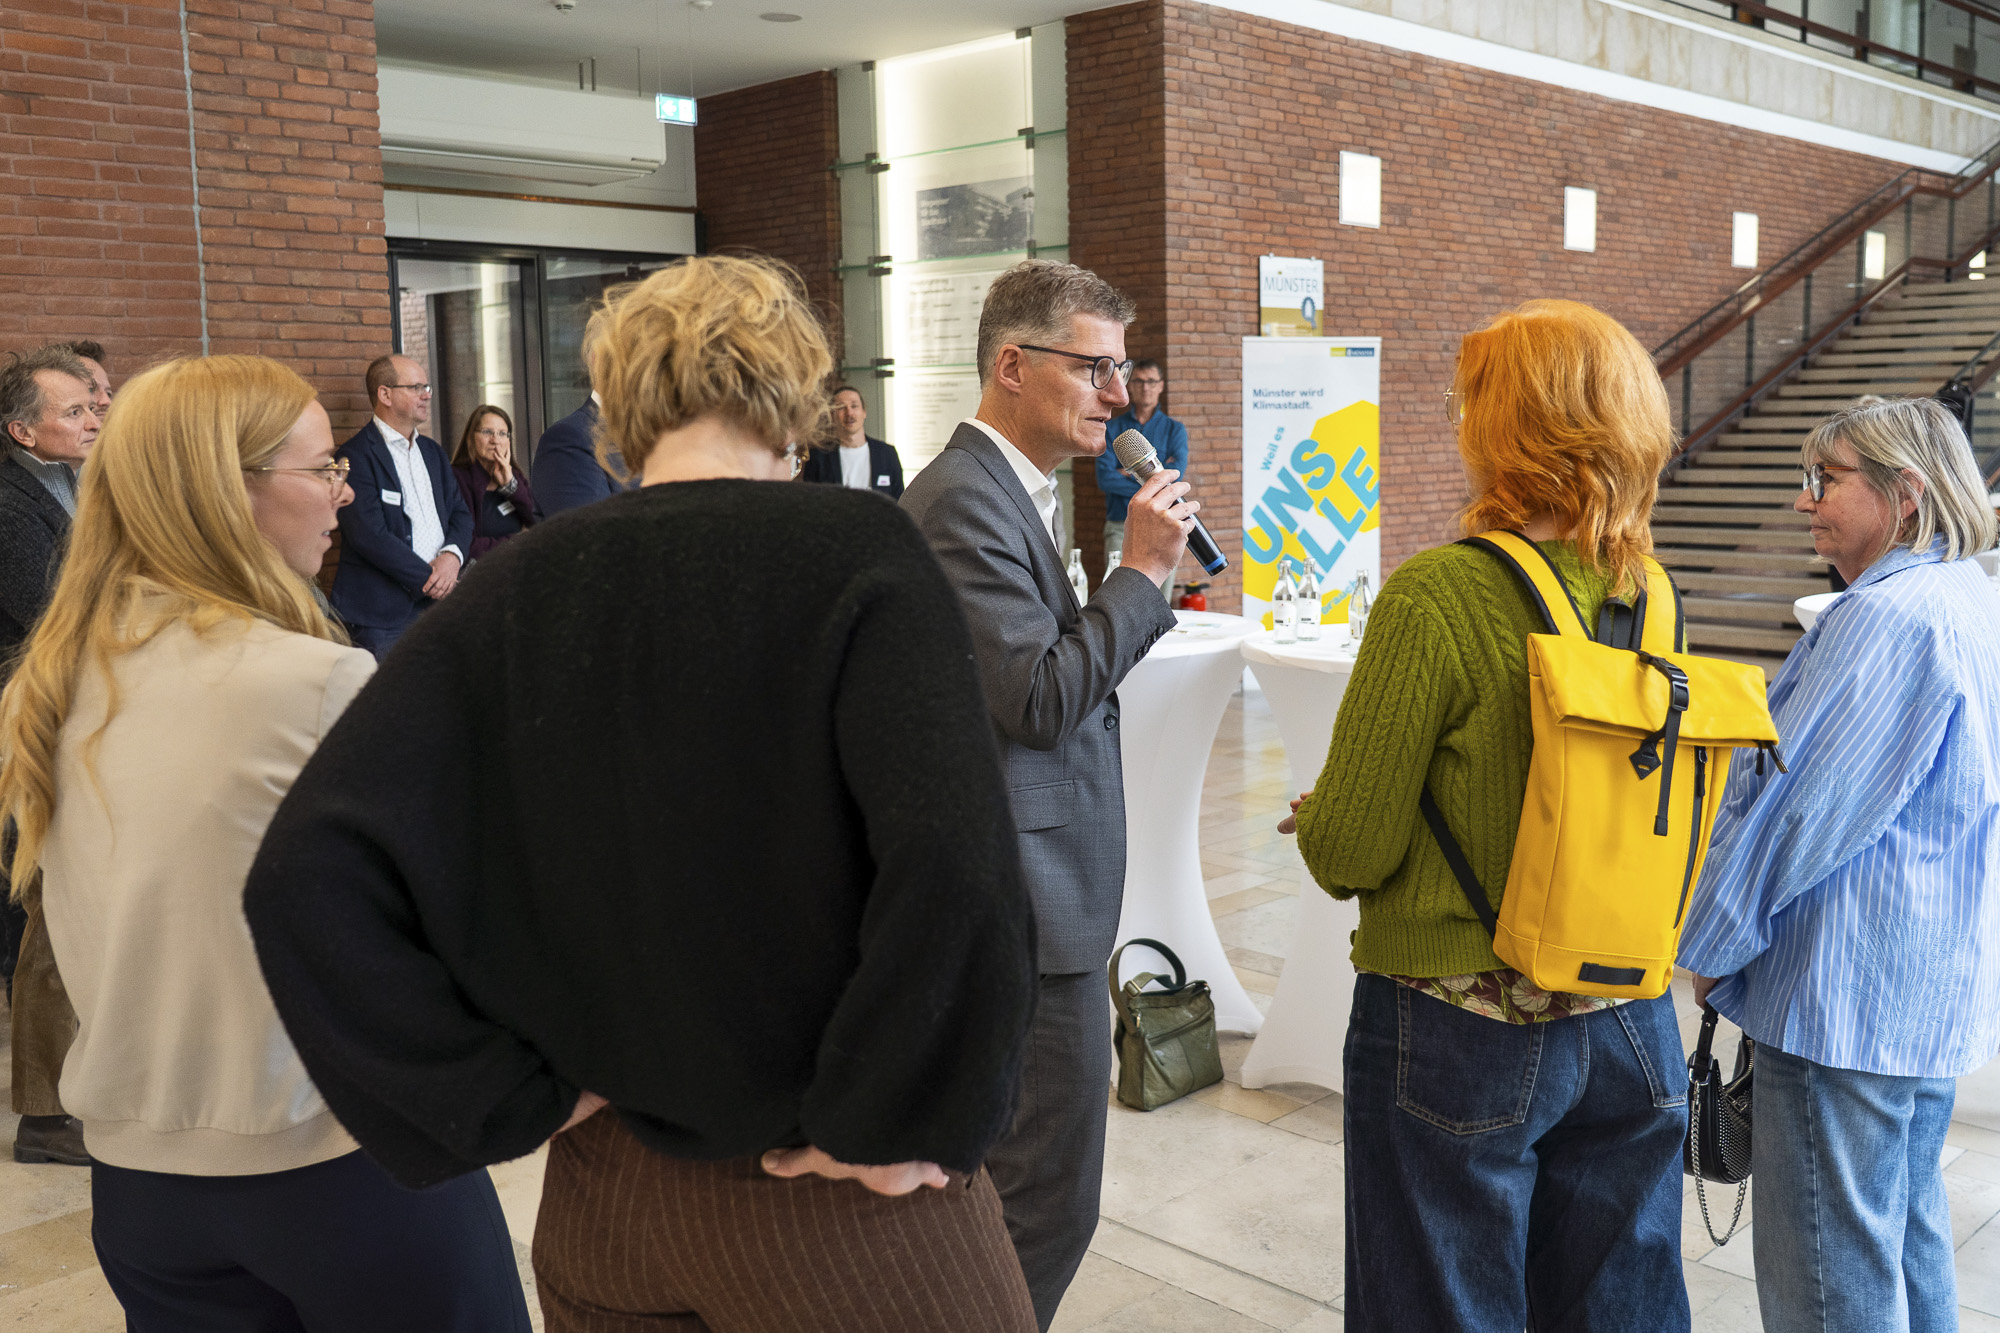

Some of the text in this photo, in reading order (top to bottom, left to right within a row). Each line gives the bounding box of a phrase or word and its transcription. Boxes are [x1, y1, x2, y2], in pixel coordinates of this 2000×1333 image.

[1253, 388, 1324, 397] Münster wird
[1253, 401, 1312, 410] Klimastadt.
[1260, 426, 1285, 471] Weil es
[1243, 439, 1336, 565] UNS
[1321, 580, 1358, 615] brauch
